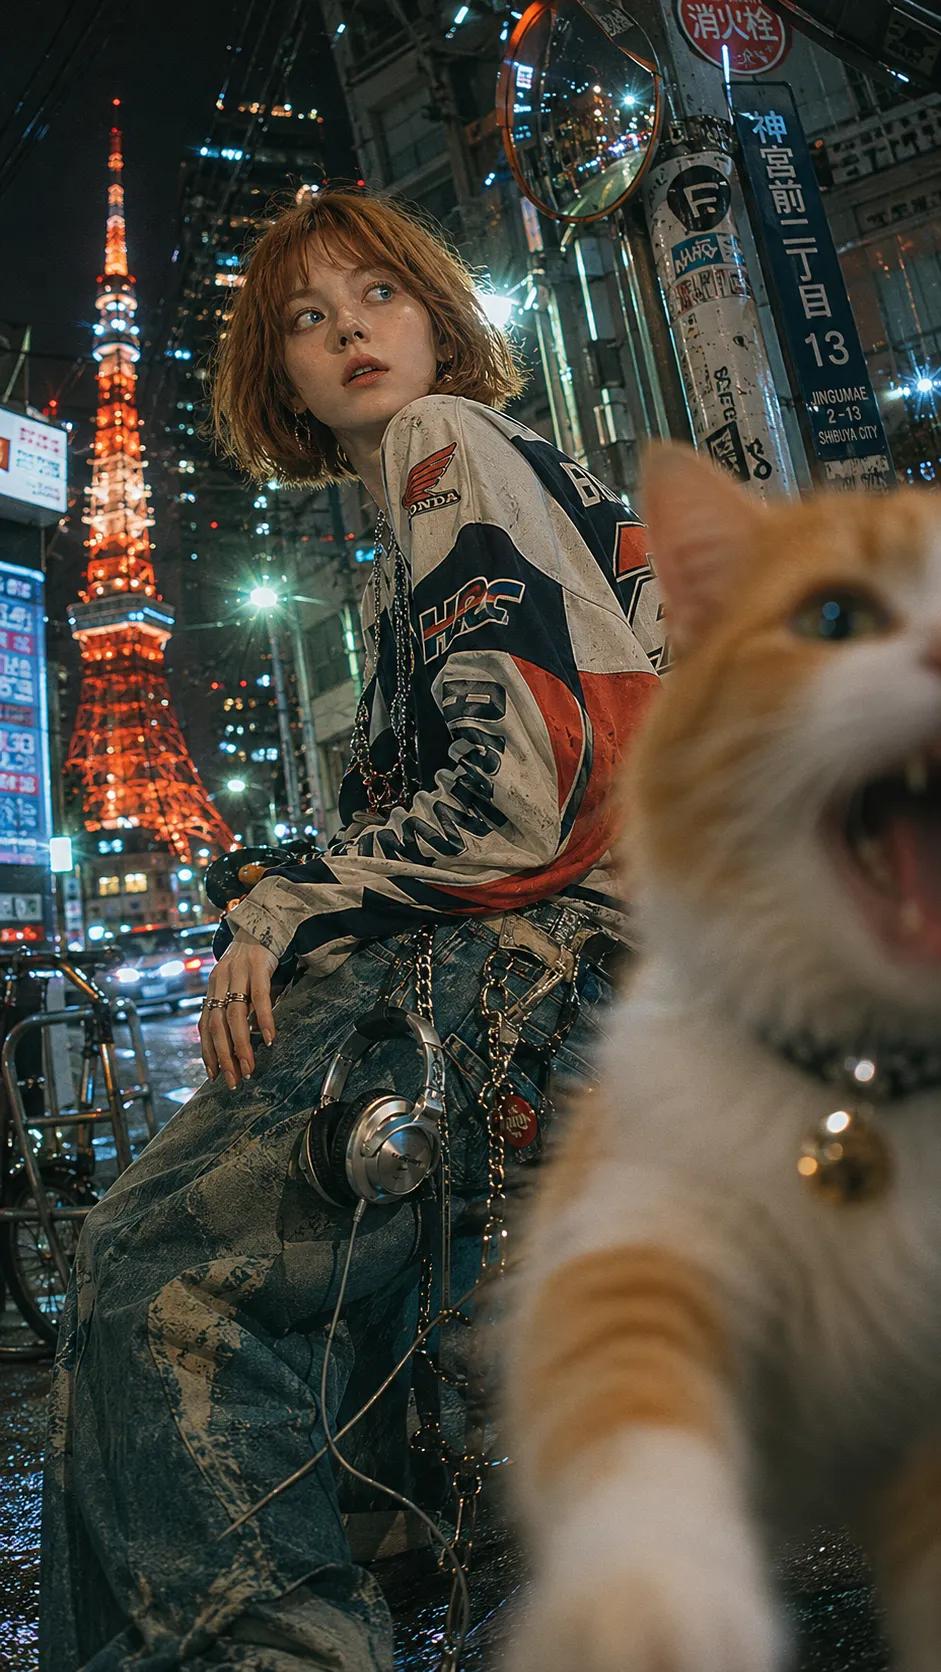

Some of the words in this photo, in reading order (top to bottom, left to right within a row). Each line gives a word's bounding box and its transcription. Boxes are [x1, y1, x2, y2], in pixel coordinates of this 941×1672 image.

[687, 4, 779, 42] 消火栓
[752, 110, 832, 319] 神宮前二丁目
[805, 331, 849, 367] 13
[811, 386, 868, 405] JINGUMAE
[827, 405, 862, 423] 2-13
[818, 427, 857, 445] SHIBUYA
[858, 425, 878, 440] CITY
